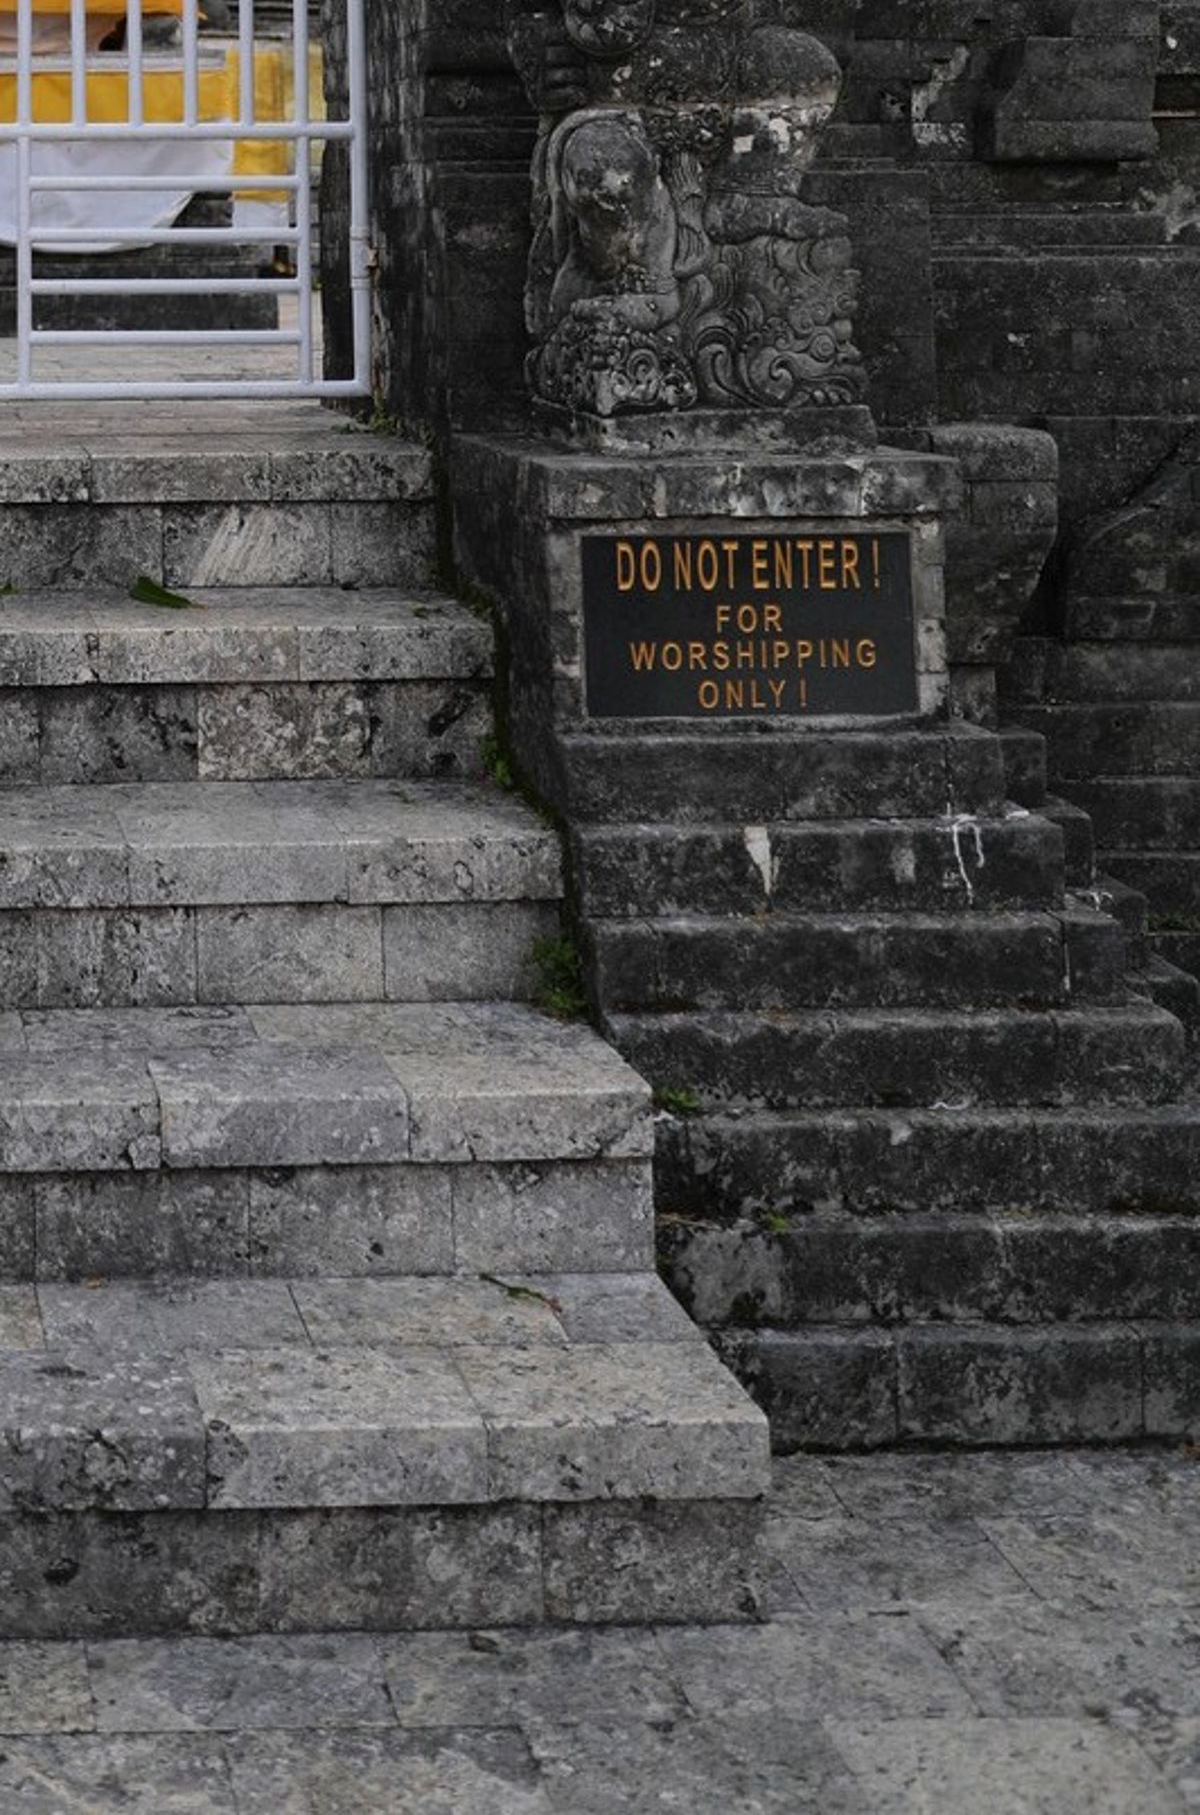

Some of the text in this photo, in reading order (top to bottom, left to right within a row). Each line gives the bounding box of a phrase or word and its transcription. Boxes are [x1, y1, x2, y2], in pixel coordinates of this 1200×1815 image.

[616, 541, 661, 590] DO
[673, 540, 738, 590] NOT
[716, 604, 782, 633] FOR
[630, 638, 877, 670] WORSHIPPING
